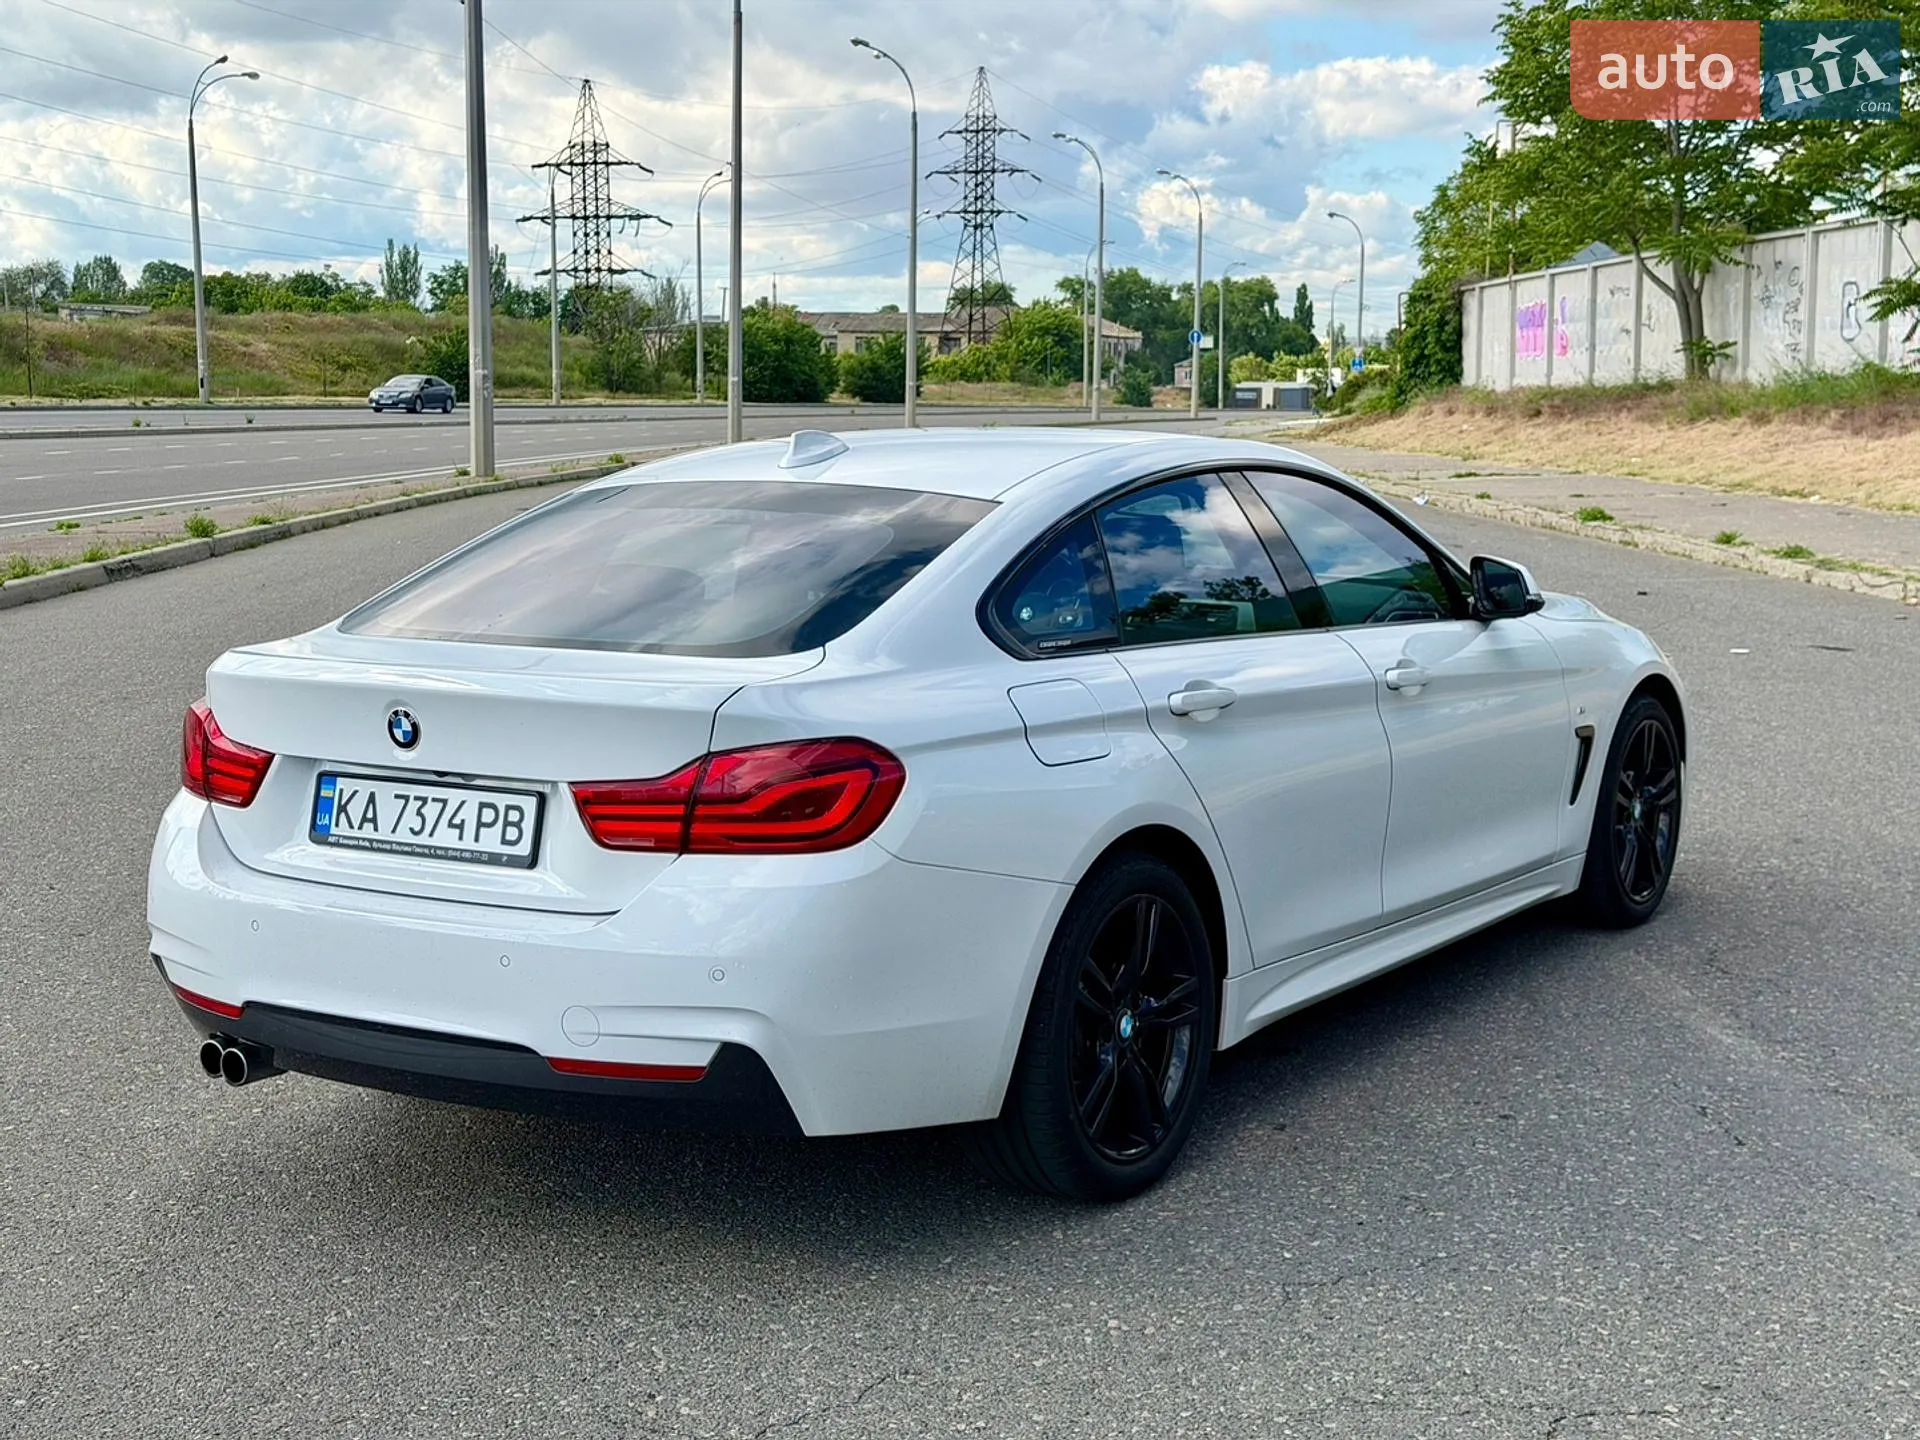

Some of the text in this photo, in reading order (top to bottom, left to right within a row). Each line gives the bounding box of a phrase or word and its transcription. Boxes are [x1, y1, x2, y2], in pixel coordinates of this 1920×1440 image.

[316, 812, 330, 826] UA
[334, 787, 525, 847] KA 7374 PB
